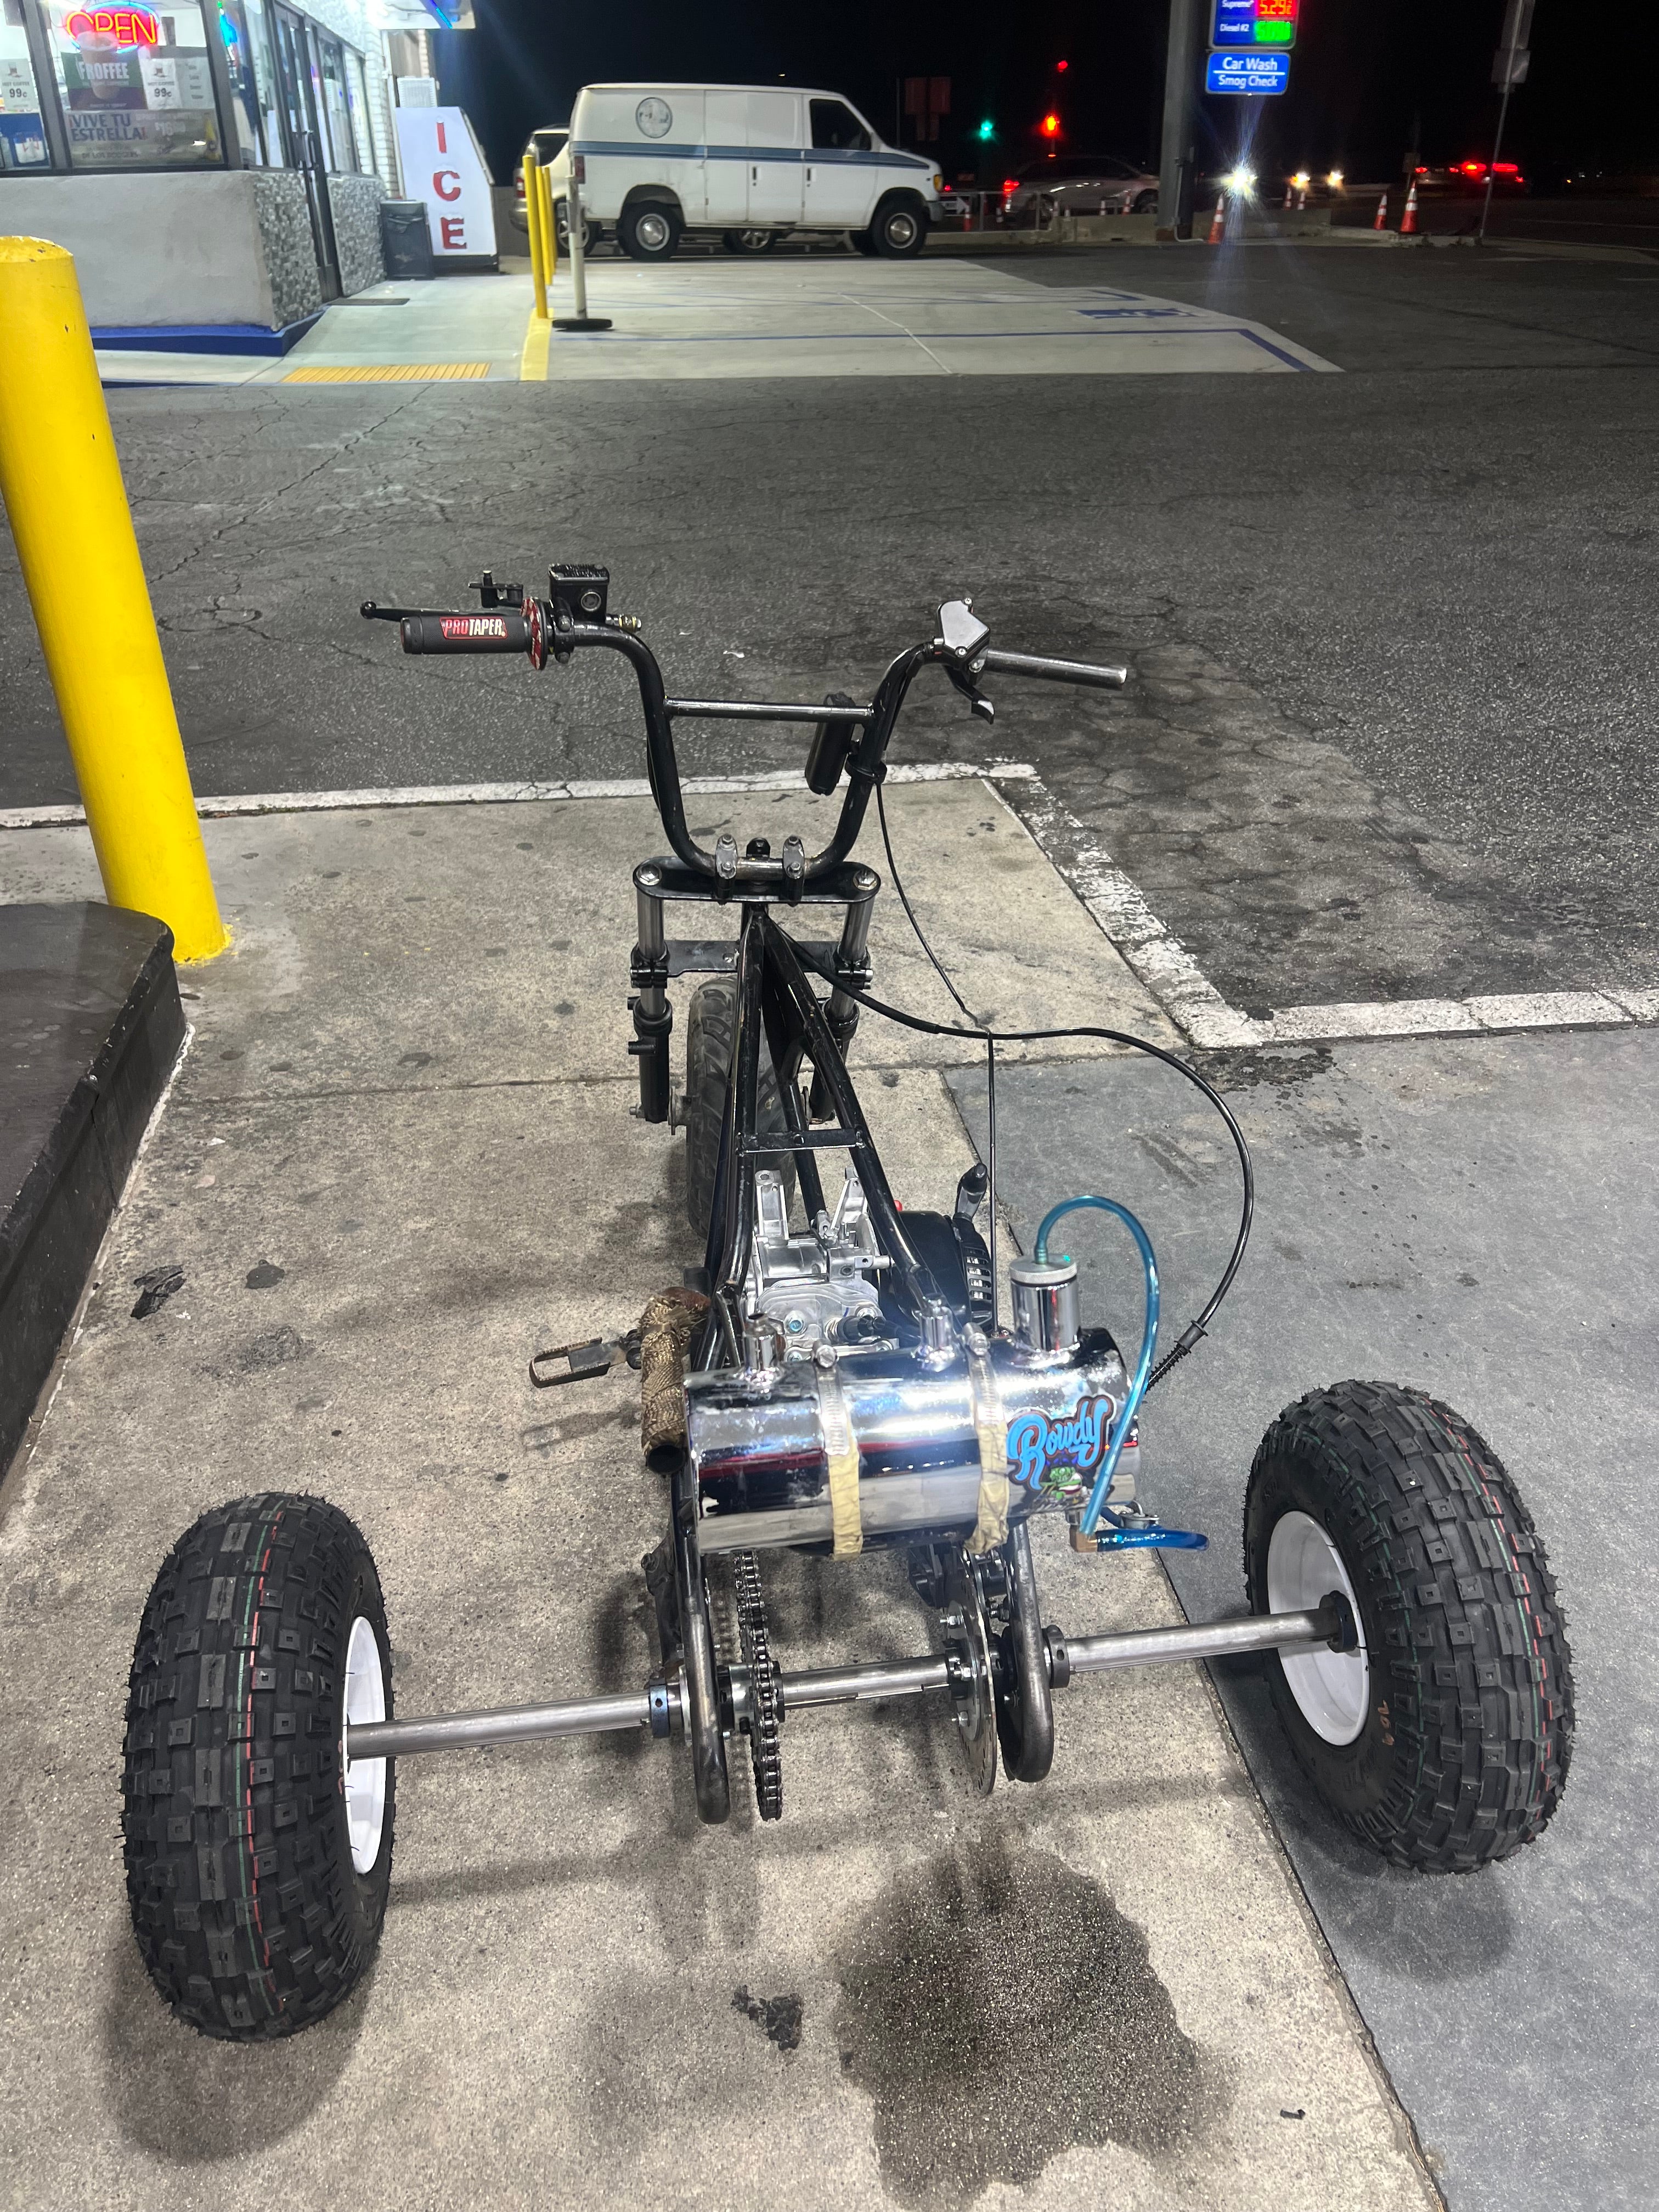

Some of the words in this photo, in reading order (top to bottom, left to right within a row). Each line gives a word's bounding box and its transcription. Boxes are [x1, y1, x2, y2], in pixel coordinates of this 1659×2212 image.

[66, 11, 156, 44] OPEN
[78, 61, 129, 80] FROFFEE
[1222, 57, 1244, 70] Car
[1245, 57, 1278, 71] Wash
[1218, 74, 1246, 89] Smog
[1248, 75, 1278, 86] Check
[112, 113, 131, 126] TU
[71, 126, 146, 142] ESTRELLA!
[433, 121, 467, 250] ICE
[444, 618, 503, 636] PROTAPER
[1006, 1399, 1109, 1491] Rowdy
